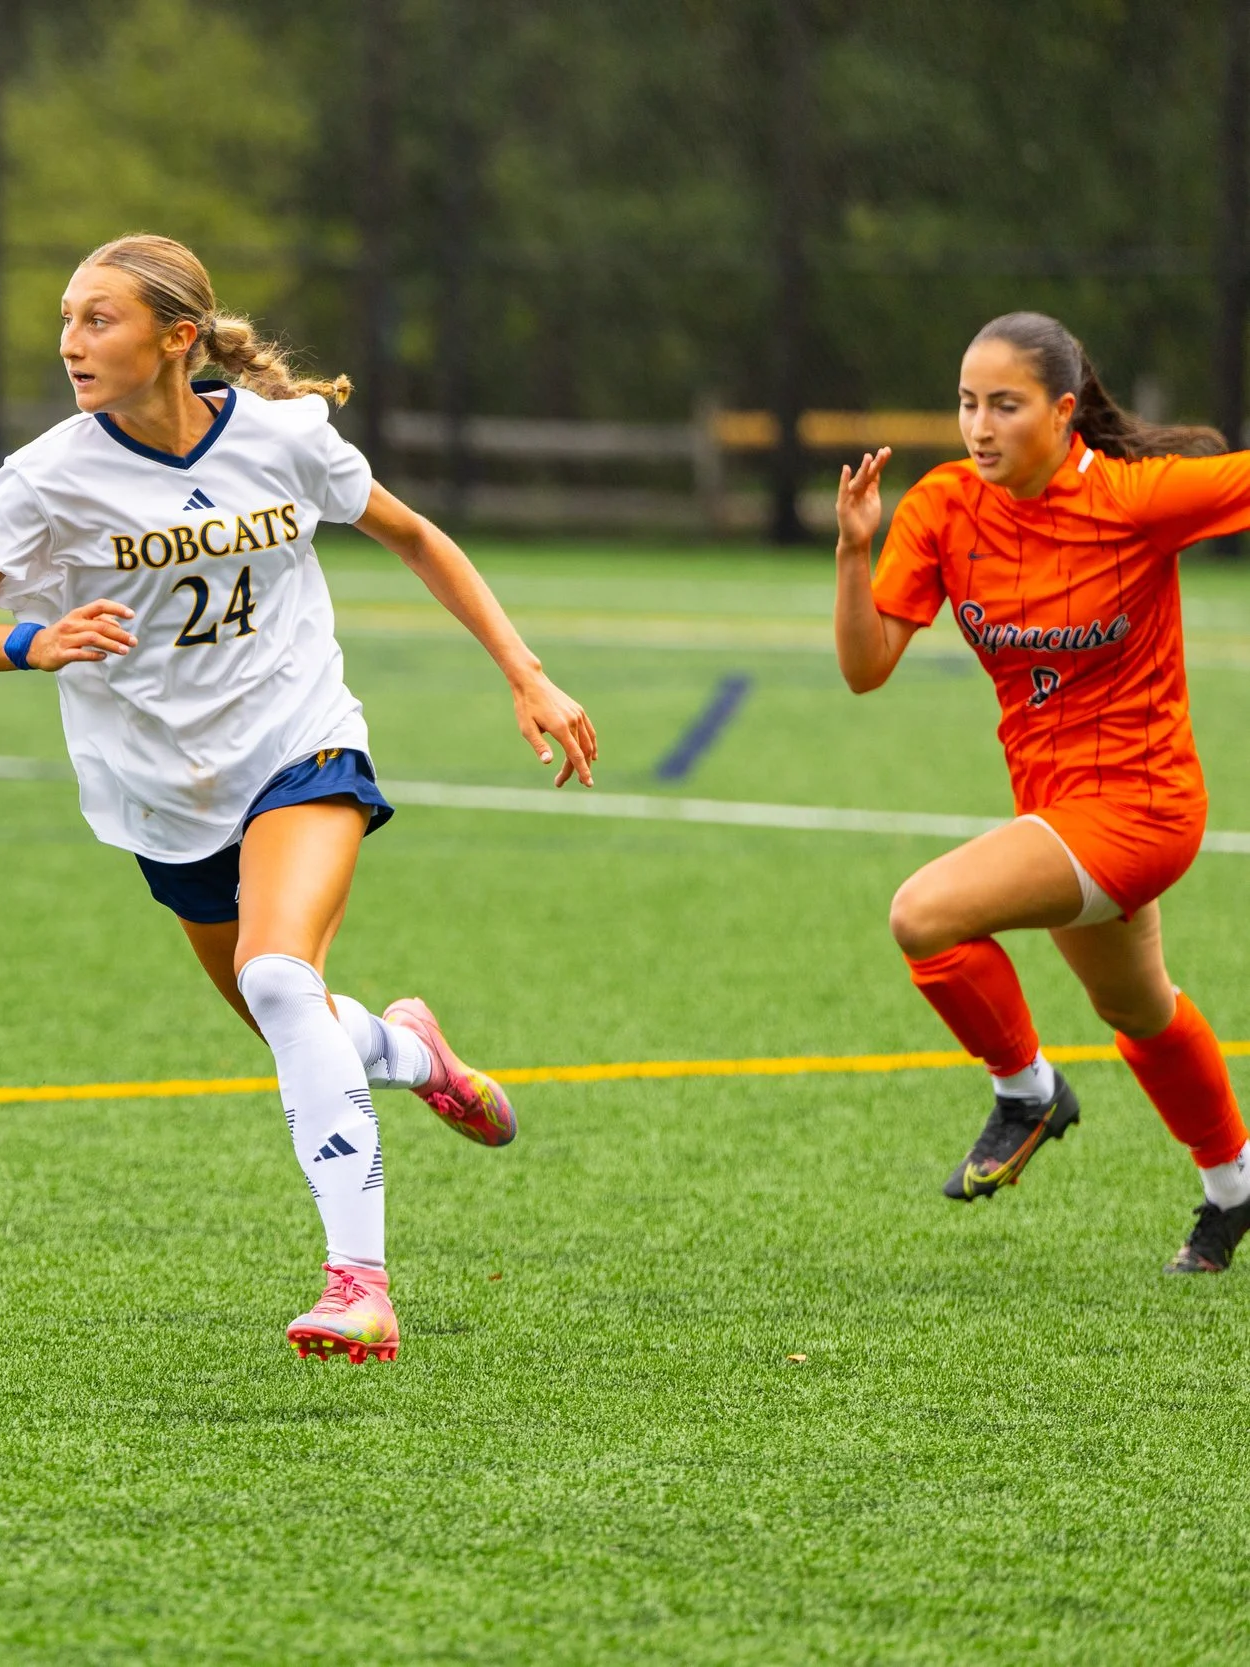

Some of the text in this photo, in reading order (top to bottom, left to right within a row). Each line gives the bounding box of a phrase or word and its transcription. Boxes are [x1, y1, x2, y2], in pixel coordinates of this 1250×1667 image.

[110, 503, 299, 571] BOBCATS
[170, 564, 258, 648] 24
[958, 600, 1132, 655] Syracuse
